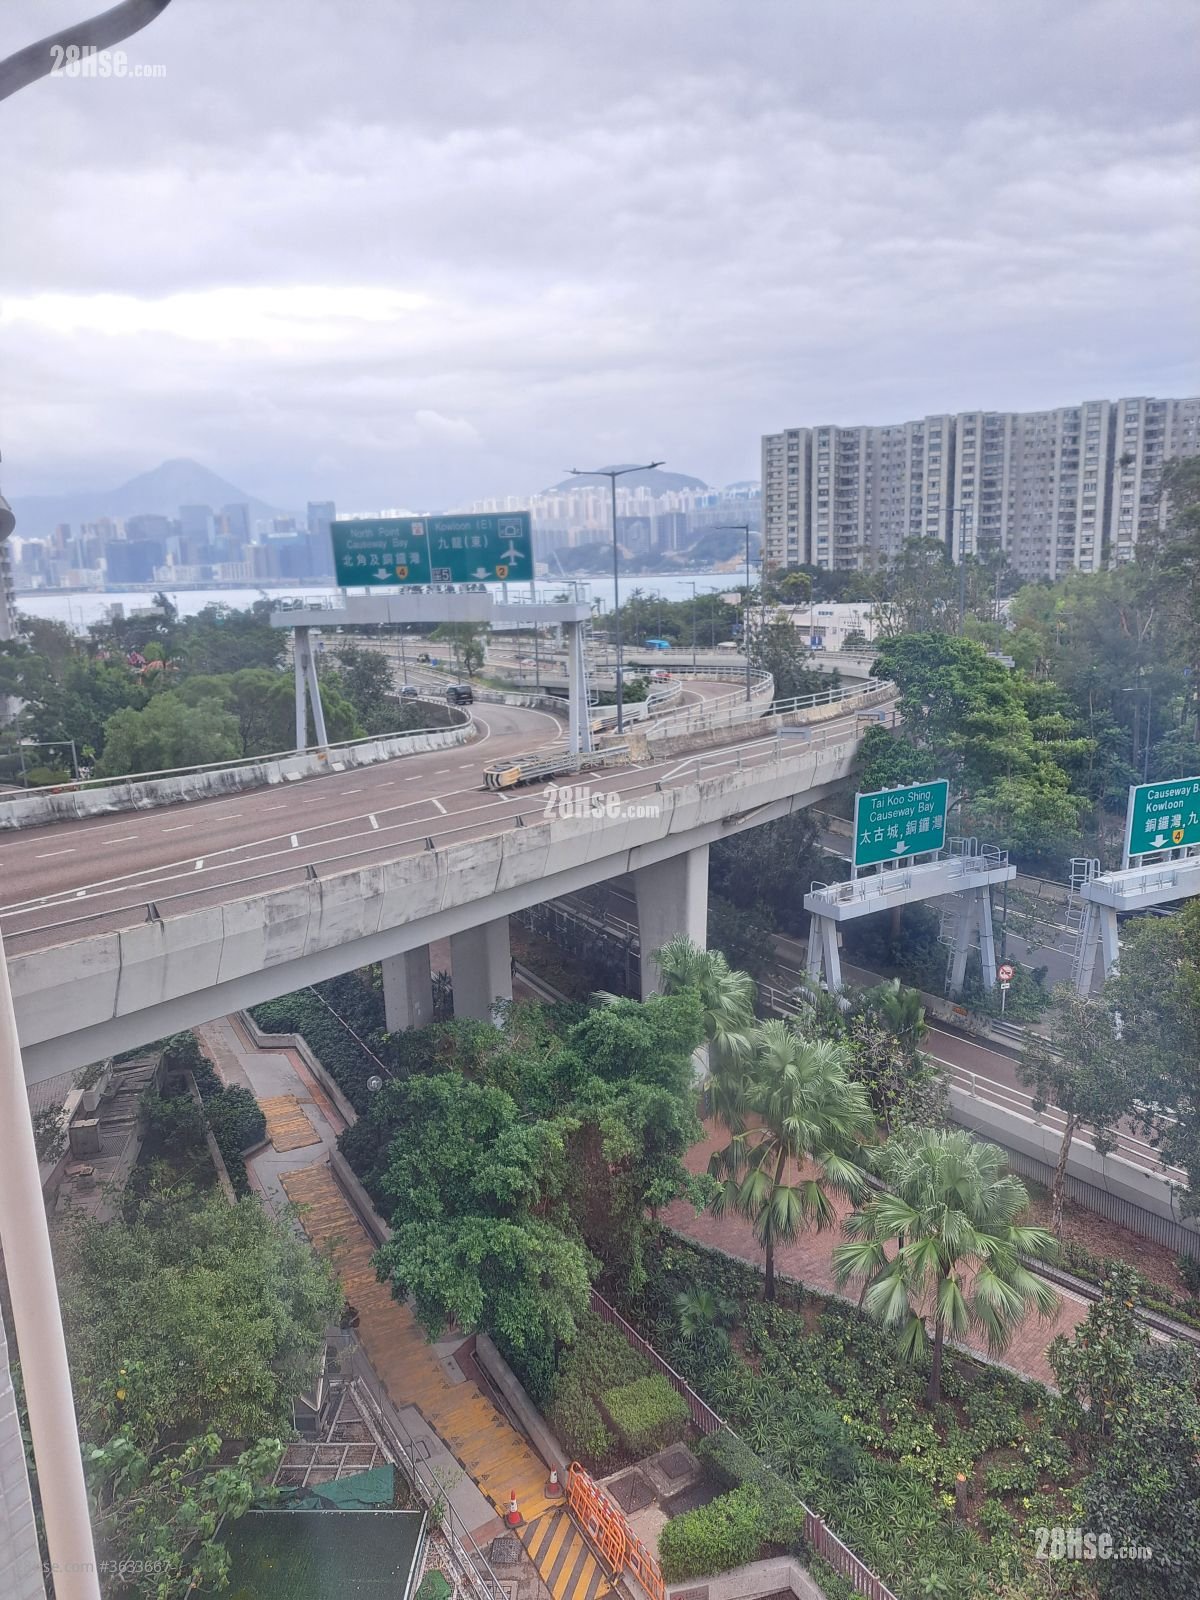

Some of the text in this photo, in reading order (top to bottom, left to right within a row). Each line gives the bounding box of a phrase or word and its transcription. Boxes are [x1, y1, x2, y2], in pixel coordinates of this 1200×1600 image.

[1147, 783, 1200, 800] Causeway B
[871, 798, 884, 809] Tai
[887, 795, 905, 806] Koo
[1145, 800, 1184, 813] Kowloon
[869, 801, 935, 823] Causeway Bay
